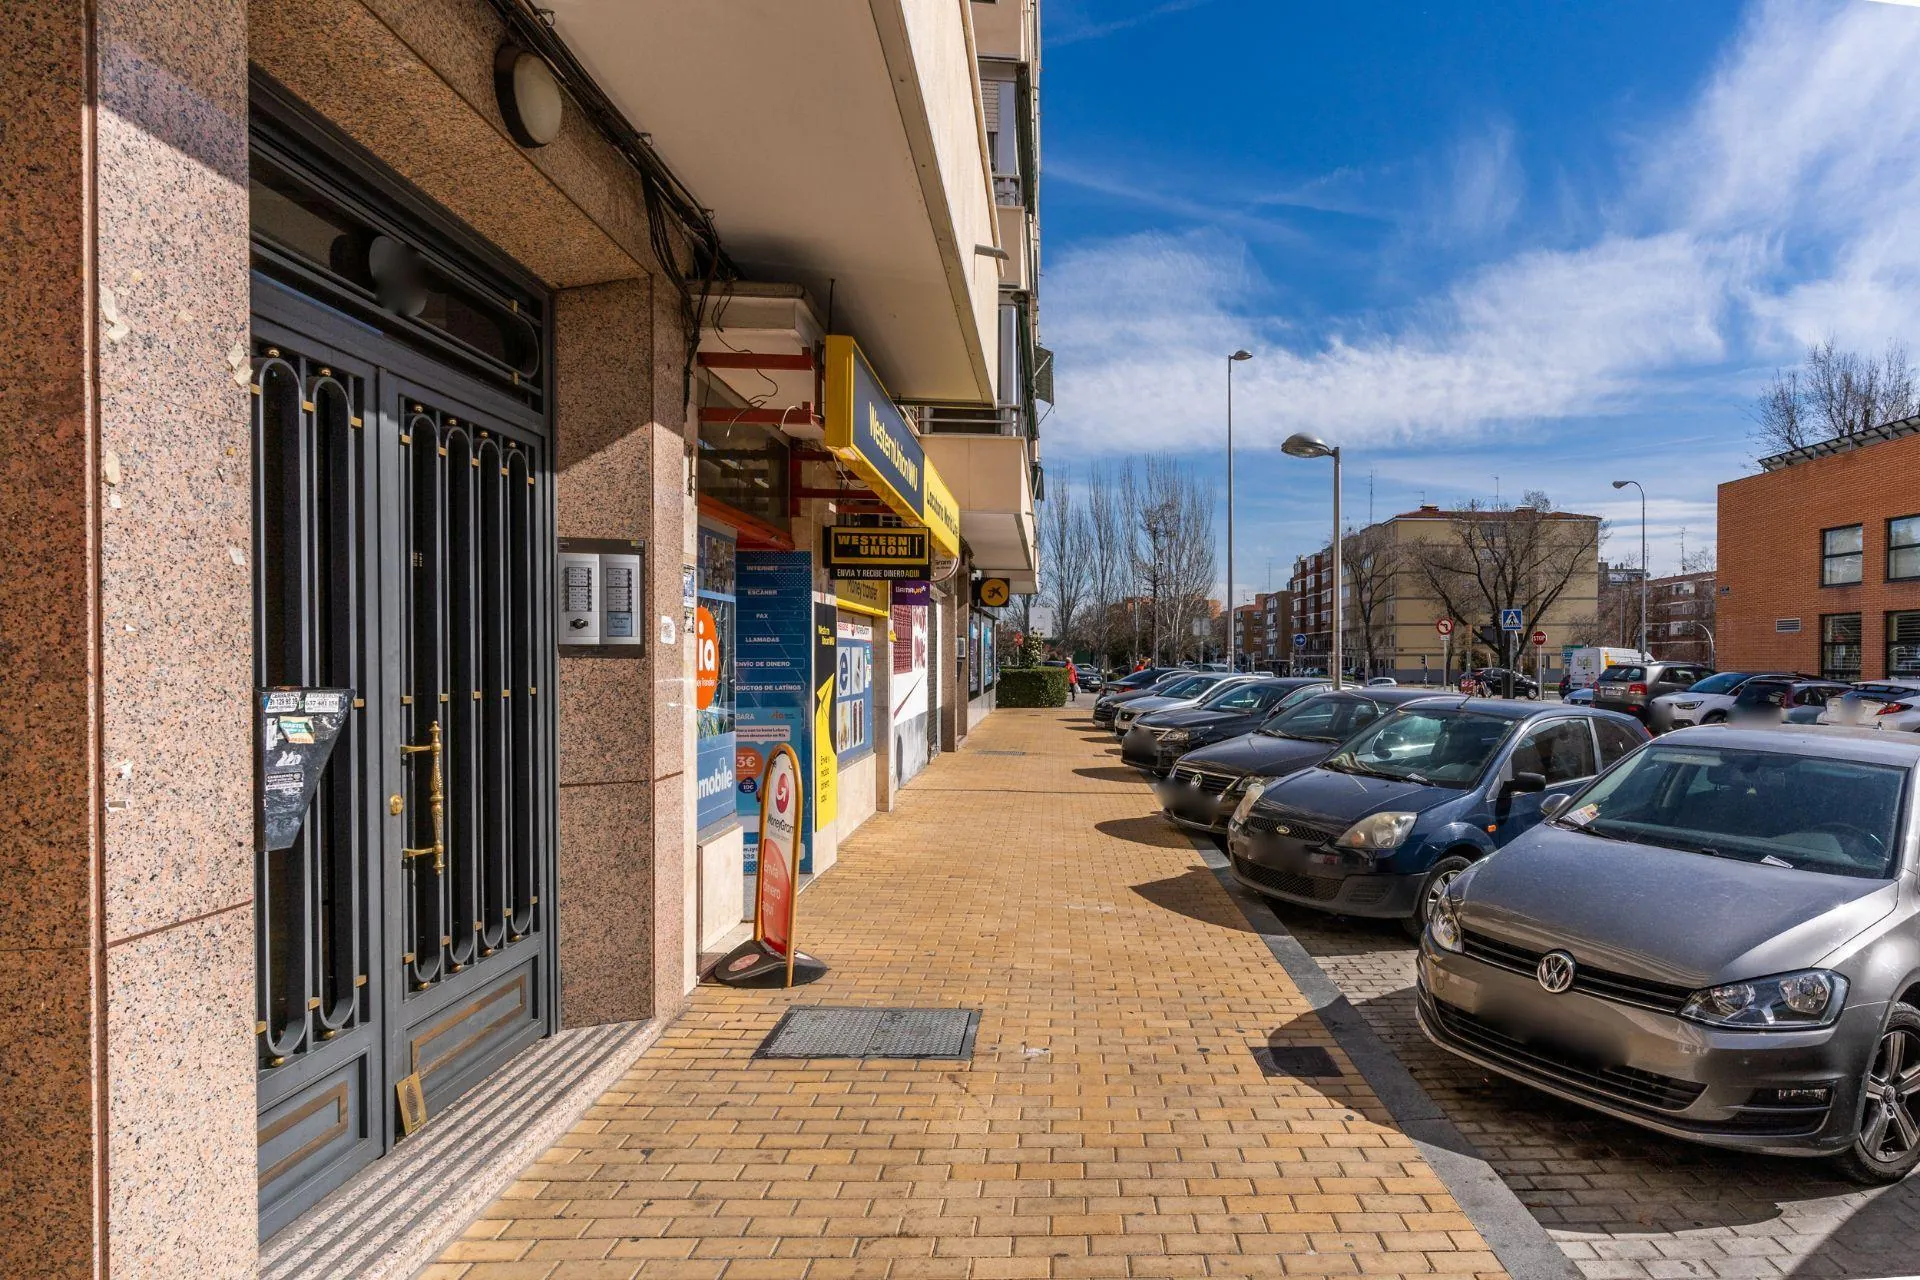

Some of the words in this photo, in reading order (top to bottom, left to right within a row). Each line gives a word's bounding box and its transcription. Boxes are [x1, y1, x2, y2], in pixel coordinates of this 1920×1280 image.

[837, 535, 908, 545] WESTERN
[860, 545, 908, 556] UNION
[857, 569, 861, 577] Y
[862, 569, 882, 578] RECIBE
[883, 569, 905, 578] DINERO
[698, 620, 715, 671] ia
[736, 713, 755, 721] BARA
[698, 766, 733, 798] mobile
